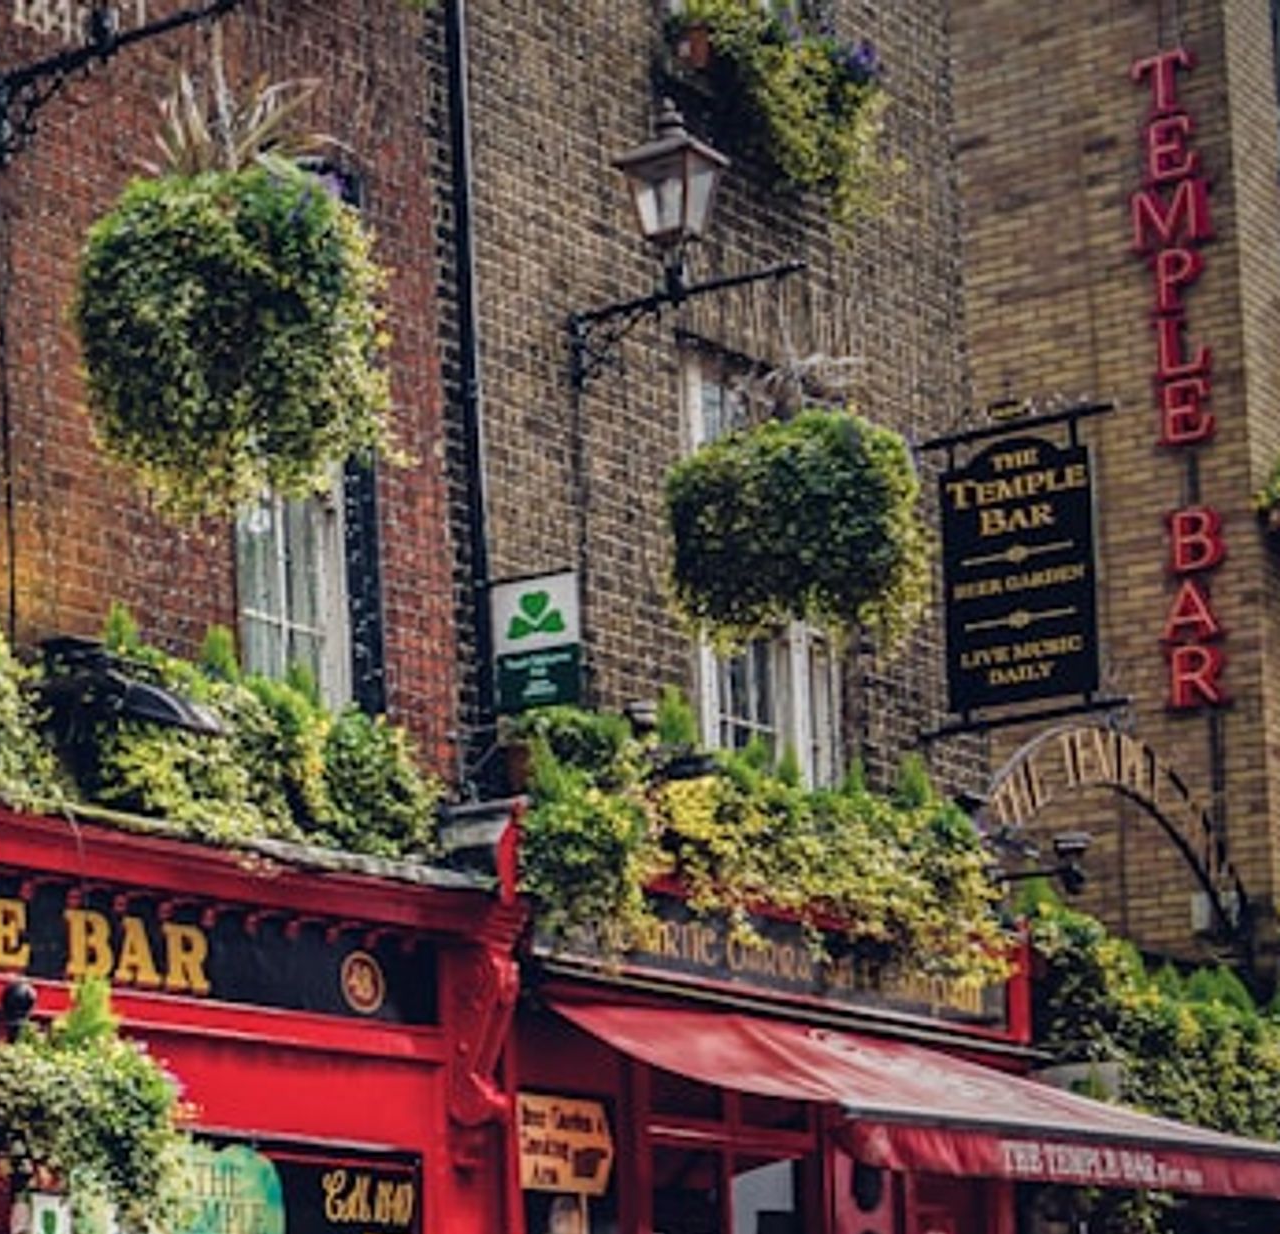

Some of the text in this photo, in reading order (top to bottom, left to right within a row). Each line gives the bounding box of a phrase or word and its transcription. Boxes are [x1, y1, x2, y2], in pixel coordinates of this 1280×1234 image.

[1131, 47, 1227, 709] TEMPLE BAR
[993, 449, 1039, 472] THE
[946, 464, 1086, 510] TEMPLE
[980, 502, 1055, 536] BAR
[953, 562, 1086, 600] BEER GARDEN
[960, 635, 1083, 670] LIVE MUSIC
[989, 660, 1056, 685] DAILY
[63, 908, 212, 995] BAR
[192, 1162, 243, 1197] THE
[1003, 1140, 1041, 1174] THE
[1043, 1143, 1120, 1180] TEMPLE
[1120, 1148, 1156, 1184] BAR
